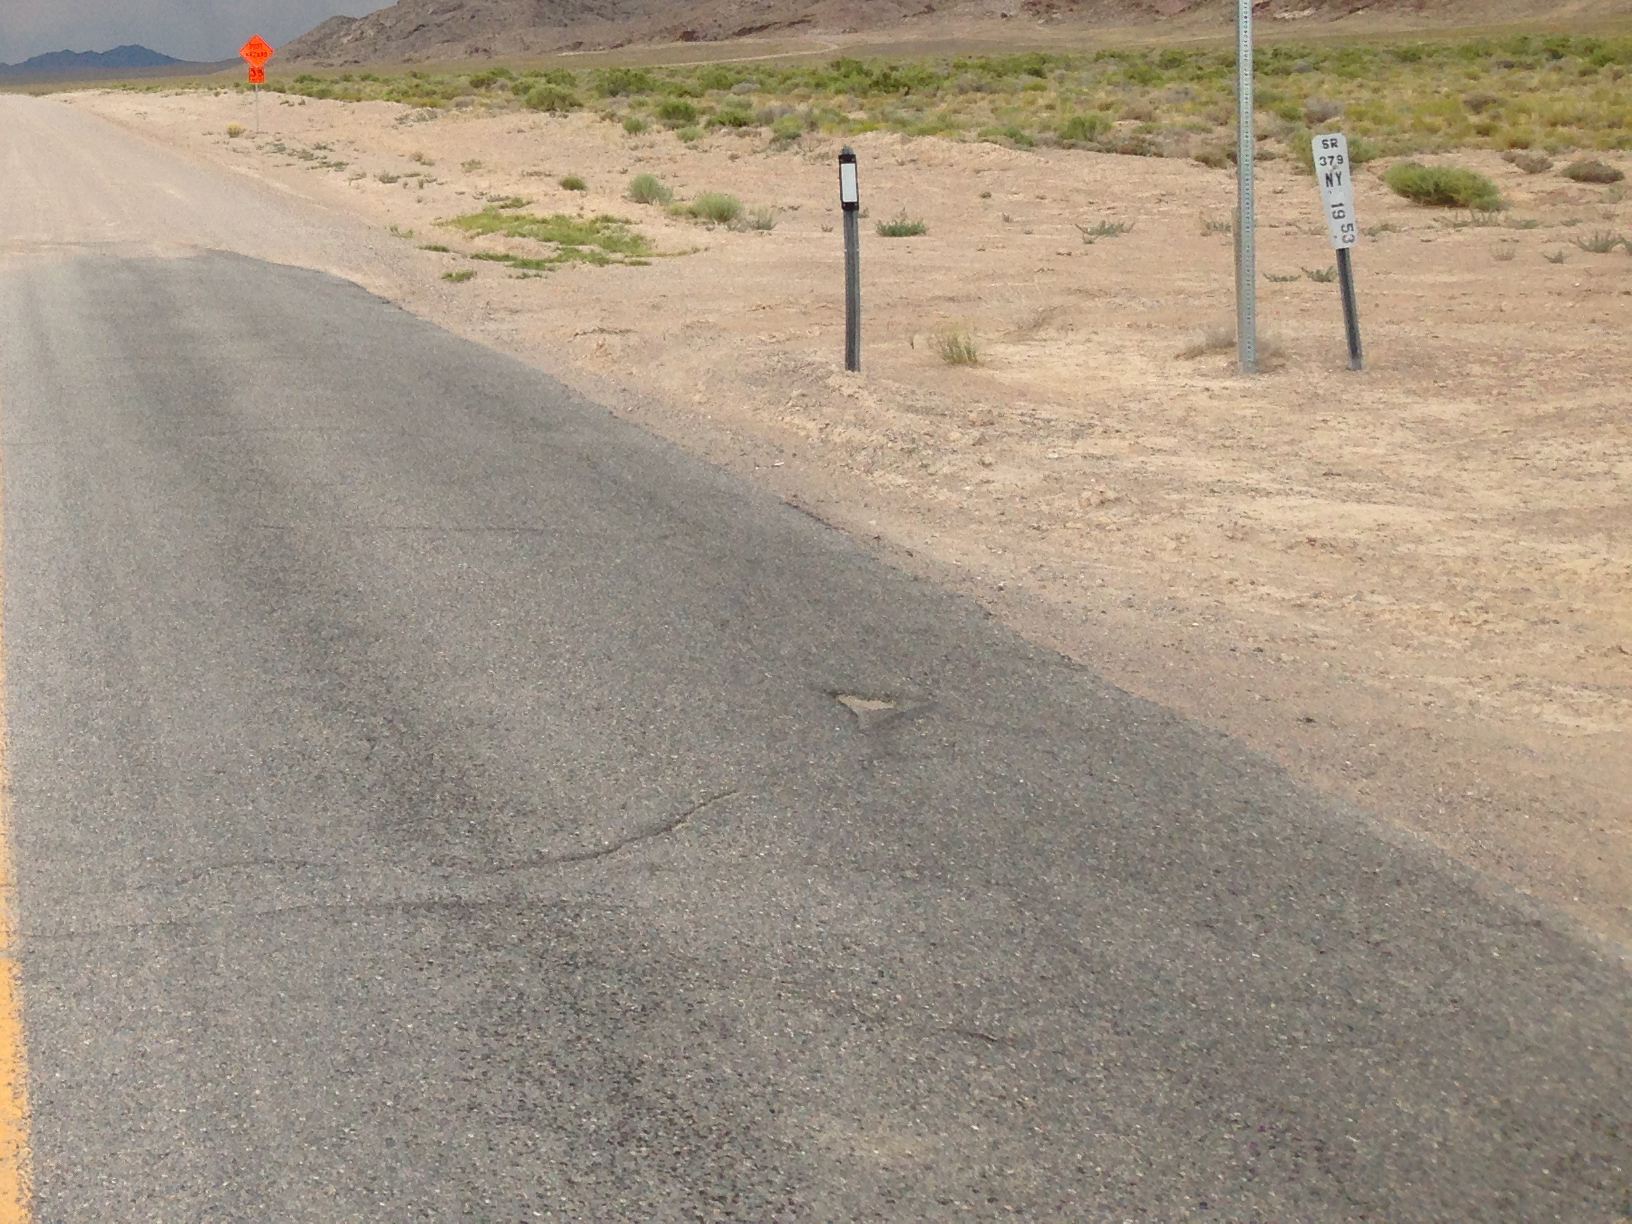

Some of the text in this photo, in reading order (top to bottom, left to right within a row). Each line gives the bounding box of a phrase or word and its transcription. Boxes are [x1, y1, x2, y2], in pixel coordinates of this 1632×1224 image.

[1321, 138, 1339, 150] SR
[1319, 154, 1344, 167] 379
[1325, 171, 1342, 188] NY
